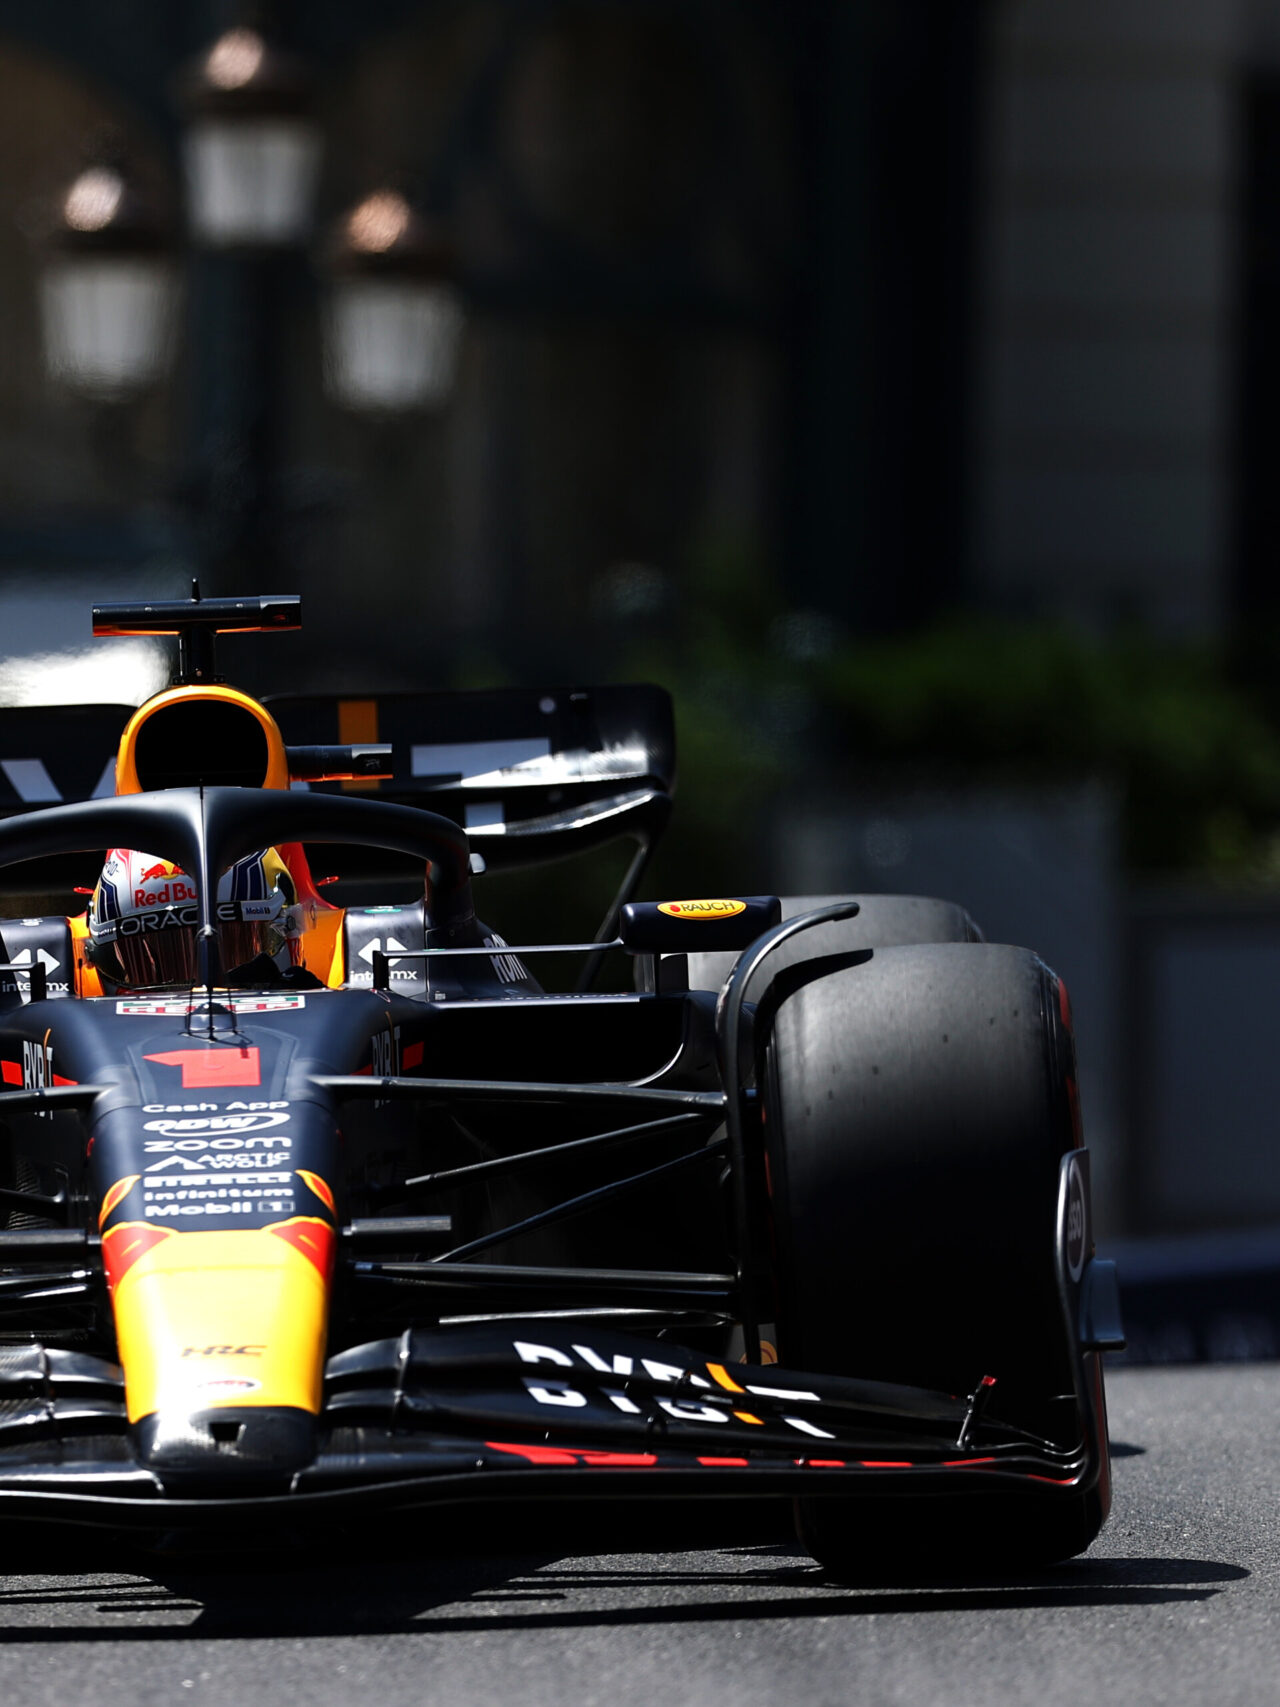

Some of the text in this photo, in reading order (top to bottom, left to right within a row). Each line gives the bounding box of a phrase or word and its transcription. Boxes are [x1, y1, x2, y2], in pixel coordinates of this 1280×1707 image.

[134, 882, 199, 908] Red Bu
[680, 902, 736, 913] RAUCH
[120, 903, 237, 936] ORACE
[349, 970, 418, 981] int.mx
[1, 980, 70, 993] intemx
[142, 1047, 261, 1088] 1
[142, 1101, 290, 1113] Cash App
[143, 1136, 292, 1152] zoom
[197, 1151, 291, 1163] ARCTIC
[209, 1159, 282, 1169] WOLF
[144, 1201, 252, 1217] Mobil
